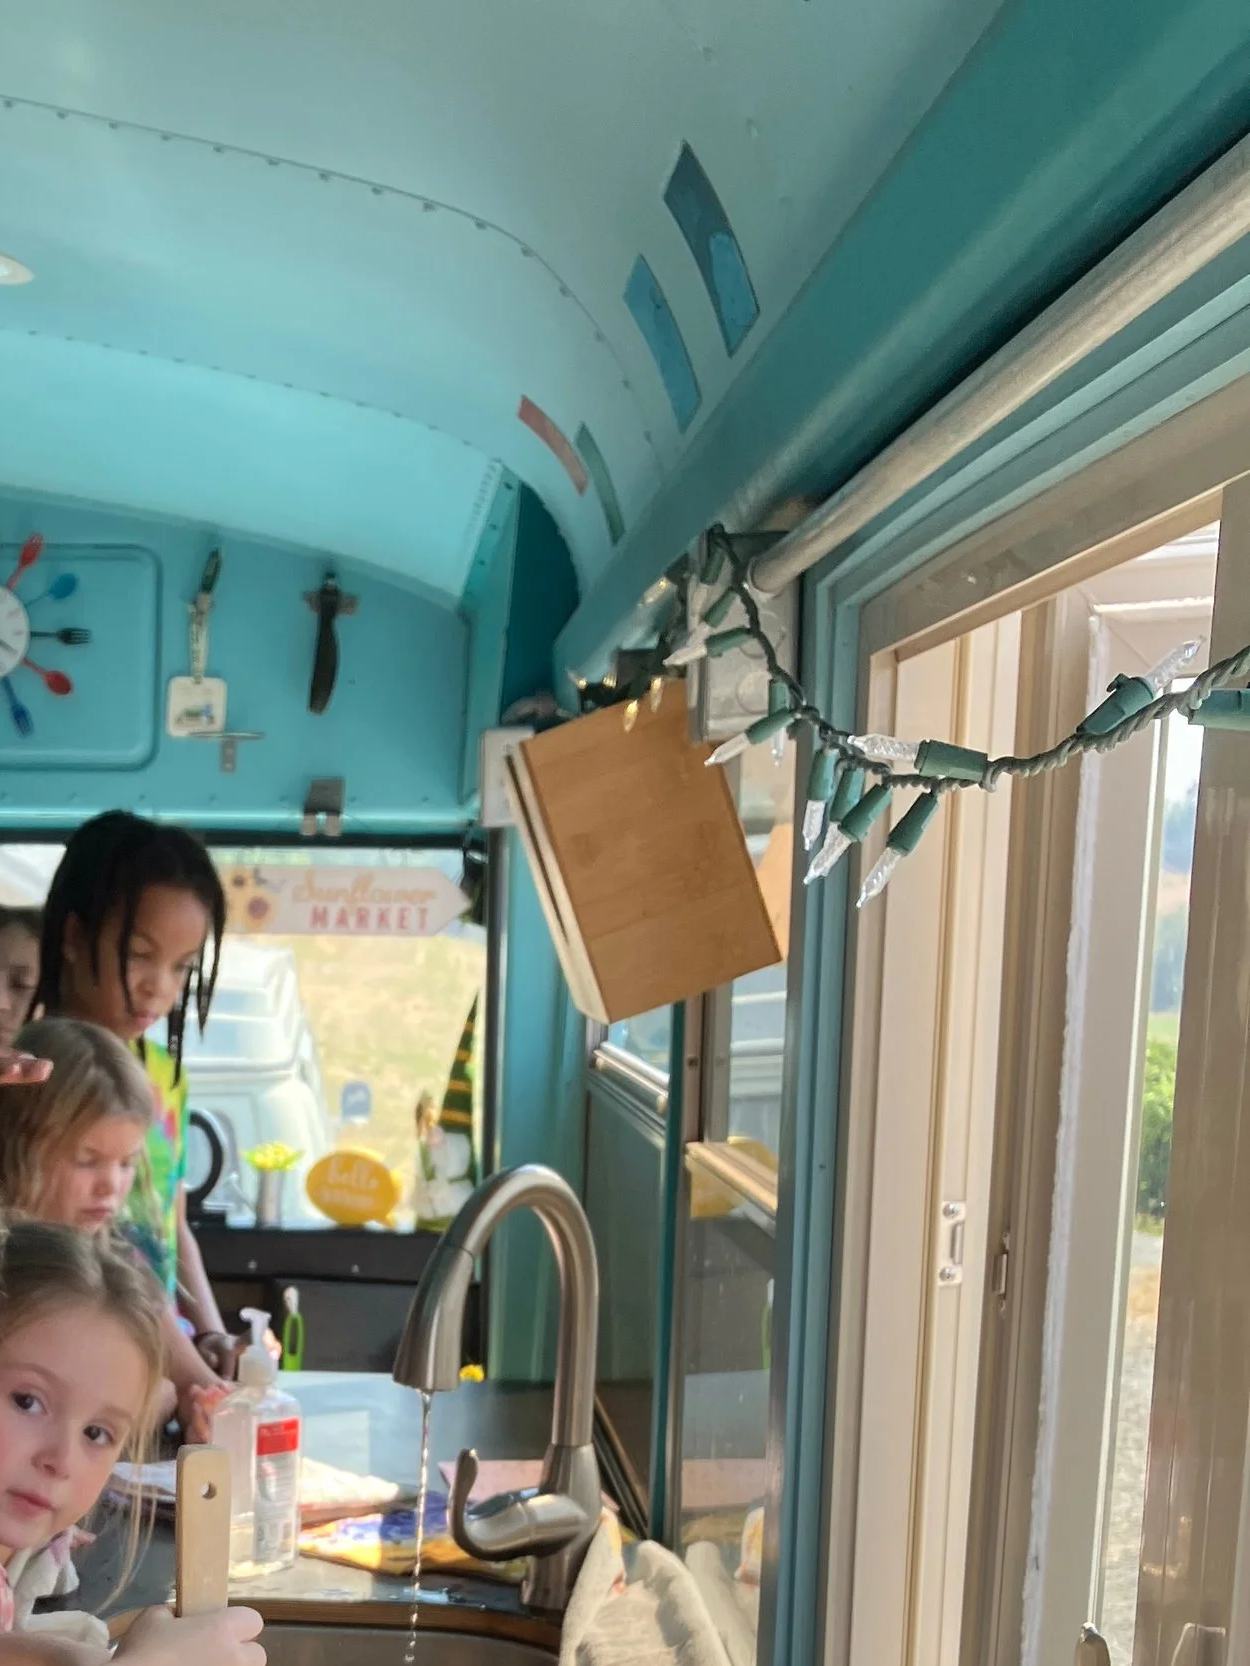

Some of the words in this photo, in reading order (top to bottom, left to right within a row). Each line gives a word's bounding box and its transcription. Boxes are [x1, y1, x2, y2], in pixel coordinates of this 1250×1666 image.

[293, 870, 436, 908] Sunflower
[311, 906, 428, 931] MARKET
[328, 1155, 379, 1189] hello
